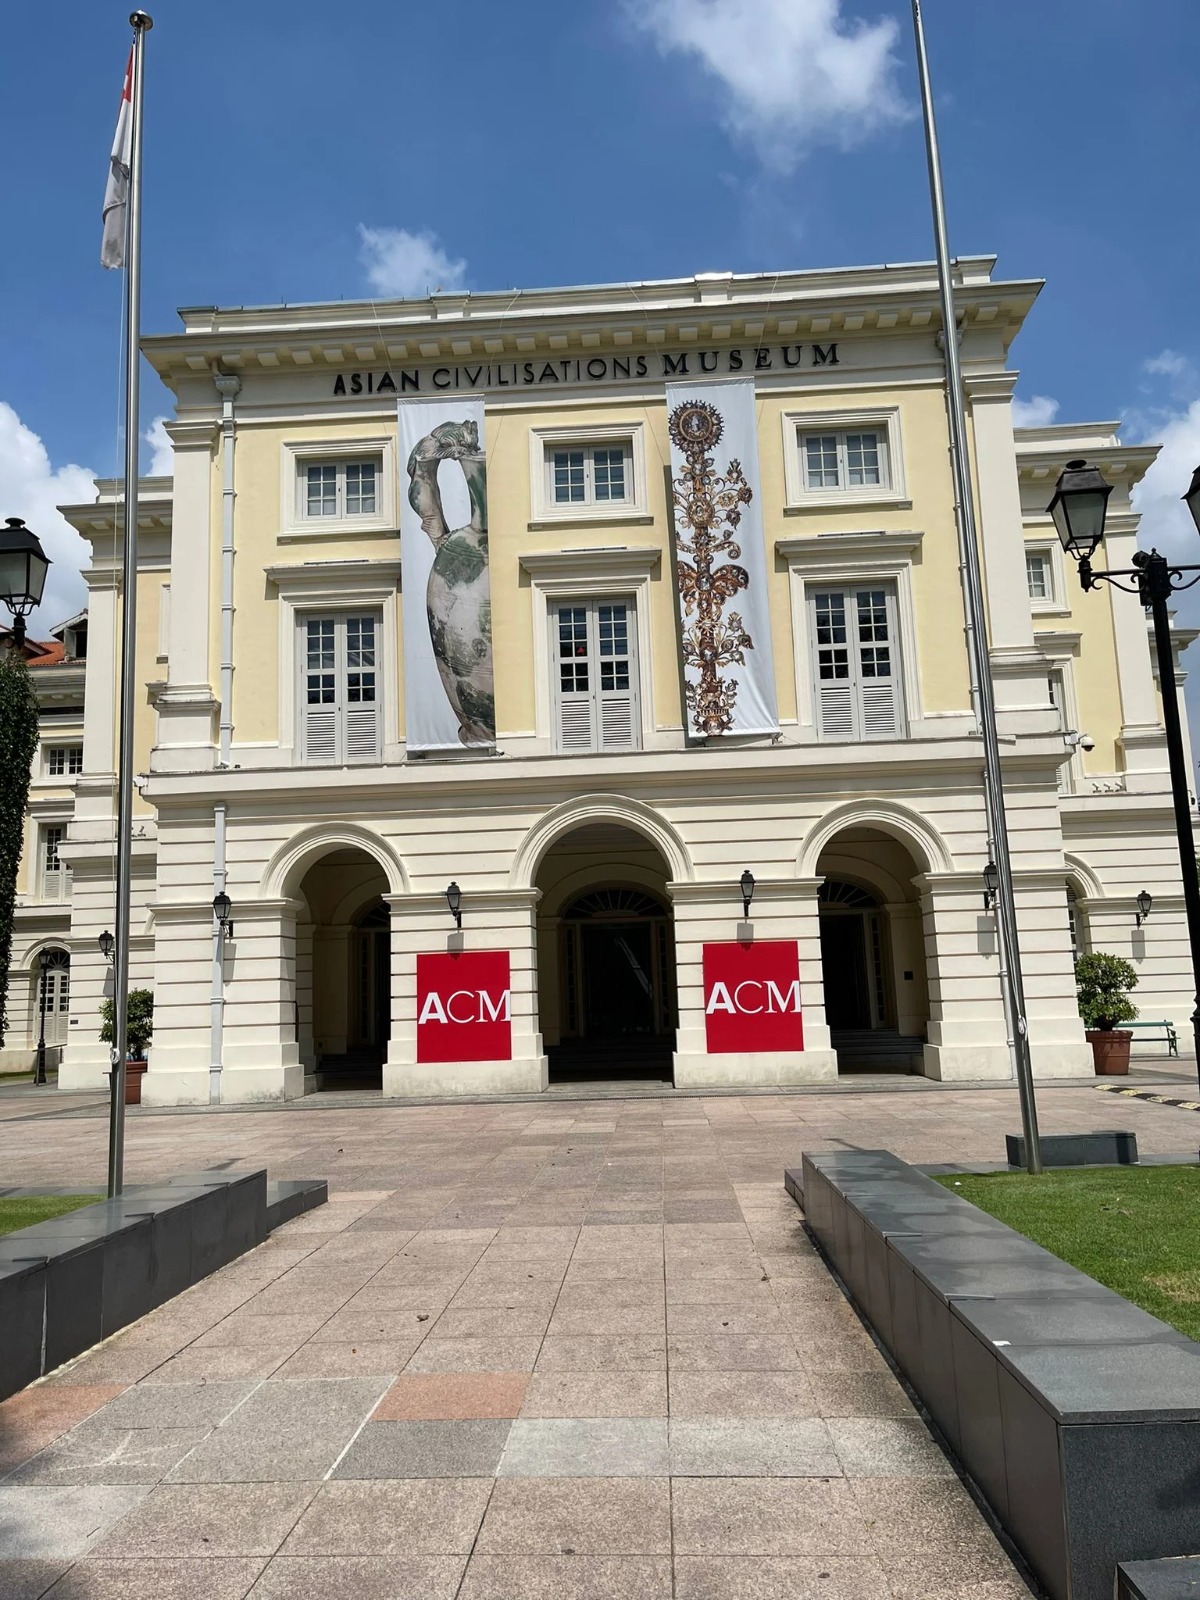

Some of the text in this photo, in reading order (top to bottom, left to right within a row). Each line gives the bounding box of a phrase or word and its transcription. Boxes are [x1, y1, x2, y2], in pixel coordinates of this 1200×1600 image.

[334, 343, 840, 396] ASIAN CIVILISATIONS MUSEUM
[418, 989, 511, 1025] ACM
[705, 980, 801, 1014] ACM
